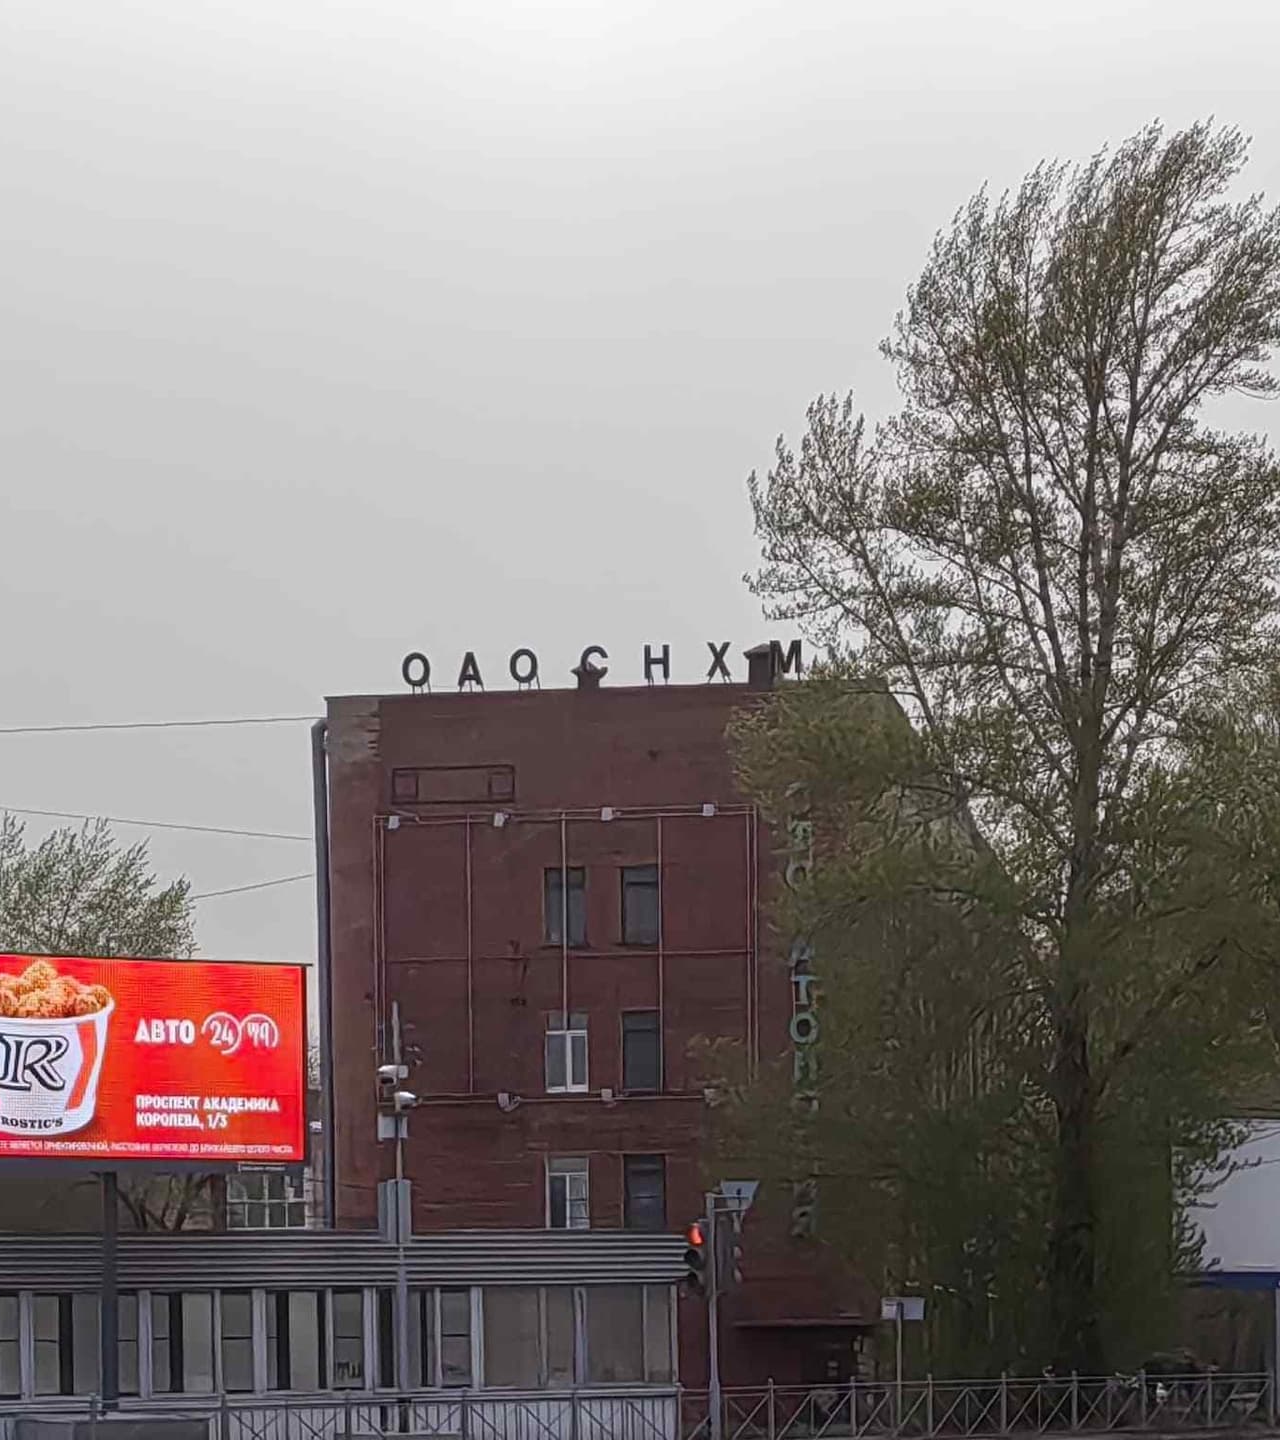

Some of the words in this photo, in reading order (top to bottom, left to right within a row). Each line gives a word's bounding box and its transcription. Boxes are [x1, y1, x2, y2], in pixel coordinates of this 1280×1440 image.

[402, 648, 537, 688] ОАО
[135, 1018, 195, 1044] АВТО
[210, 1020, 235, 1046] 24
[136, 1095, 200, 1110] ПРОСПЕКТ
[203, 1097, 279, 1112] АКАДЕМИКА
[0, 1115, 63, 1128] ROSTIC'S
[136, 1112, 204, 1130] КОРОЛЕВА,
